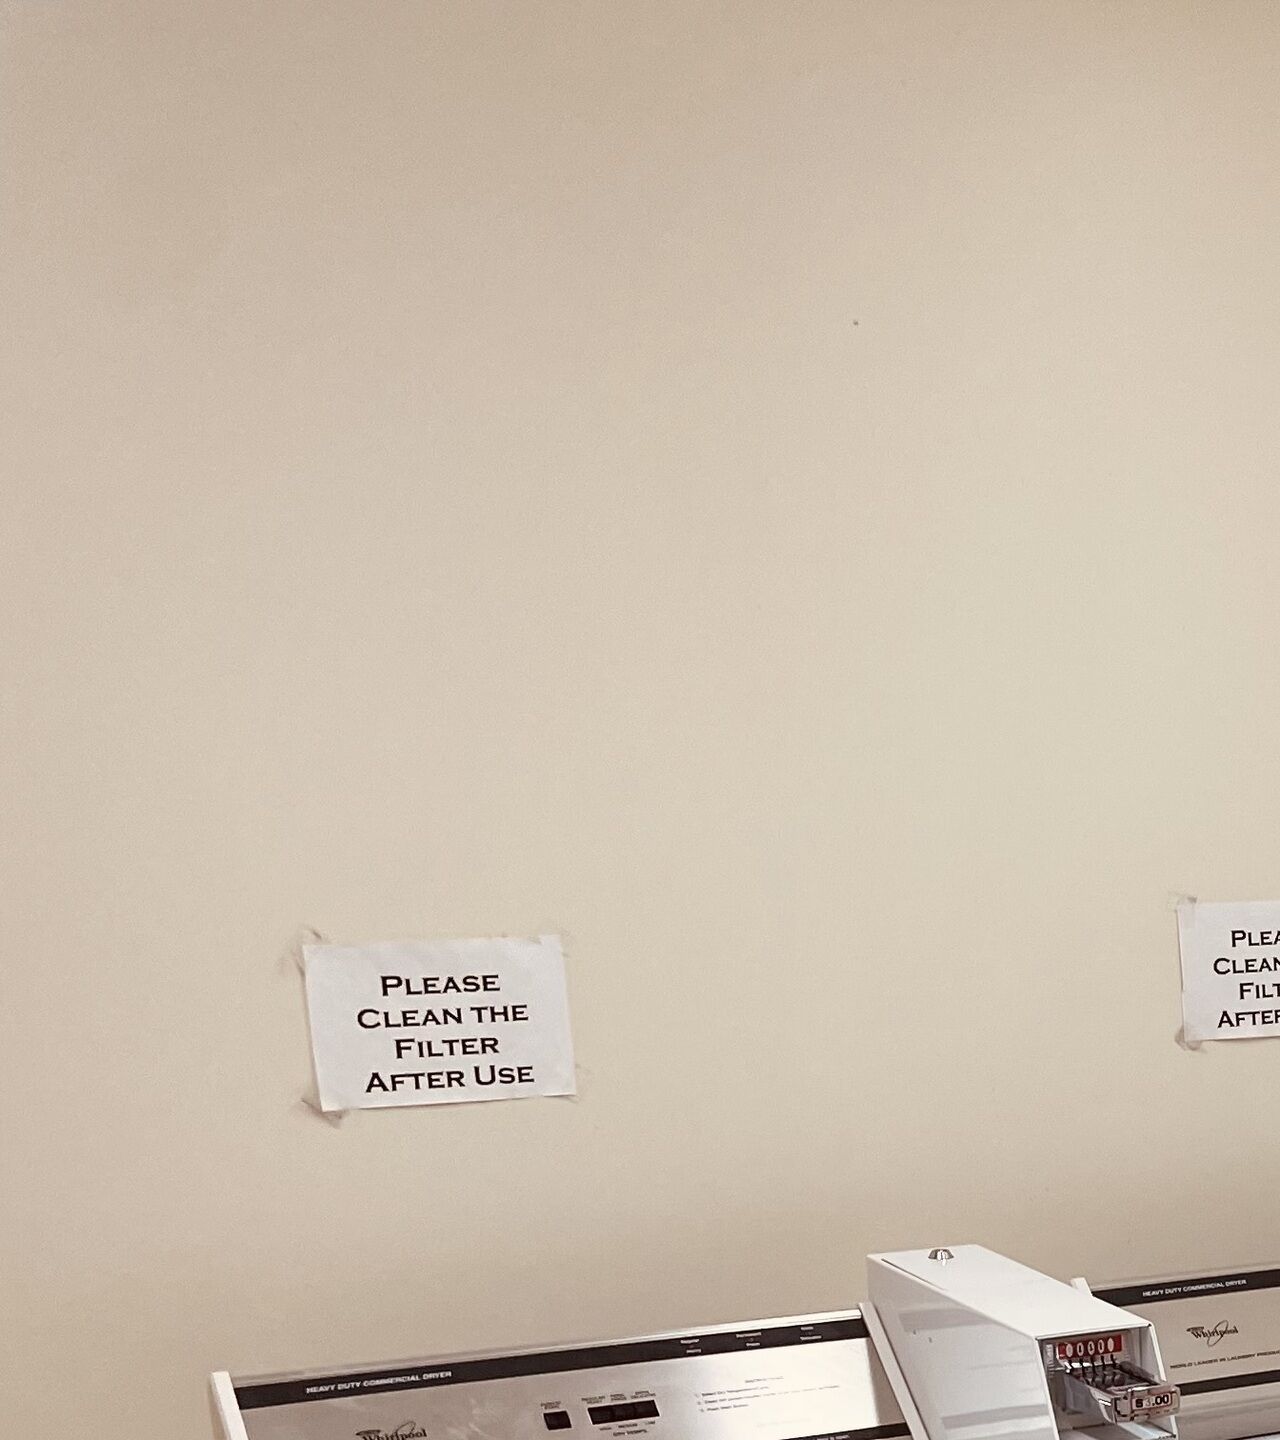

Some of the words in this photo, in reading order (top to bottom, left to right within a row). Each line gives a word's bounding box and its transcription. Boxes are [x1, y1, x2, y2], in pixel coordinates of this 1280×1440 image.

[380, 974, 501, 997] PLEASE
[357, 1007, 462, 1029] CLEAN
[470, 1004, 529, 1023] THE
[394, 1037, 500, 1059] FILTER
[365, 1070, 466, 1093] AFTER
[474, 1064, 535, 1086] USE
